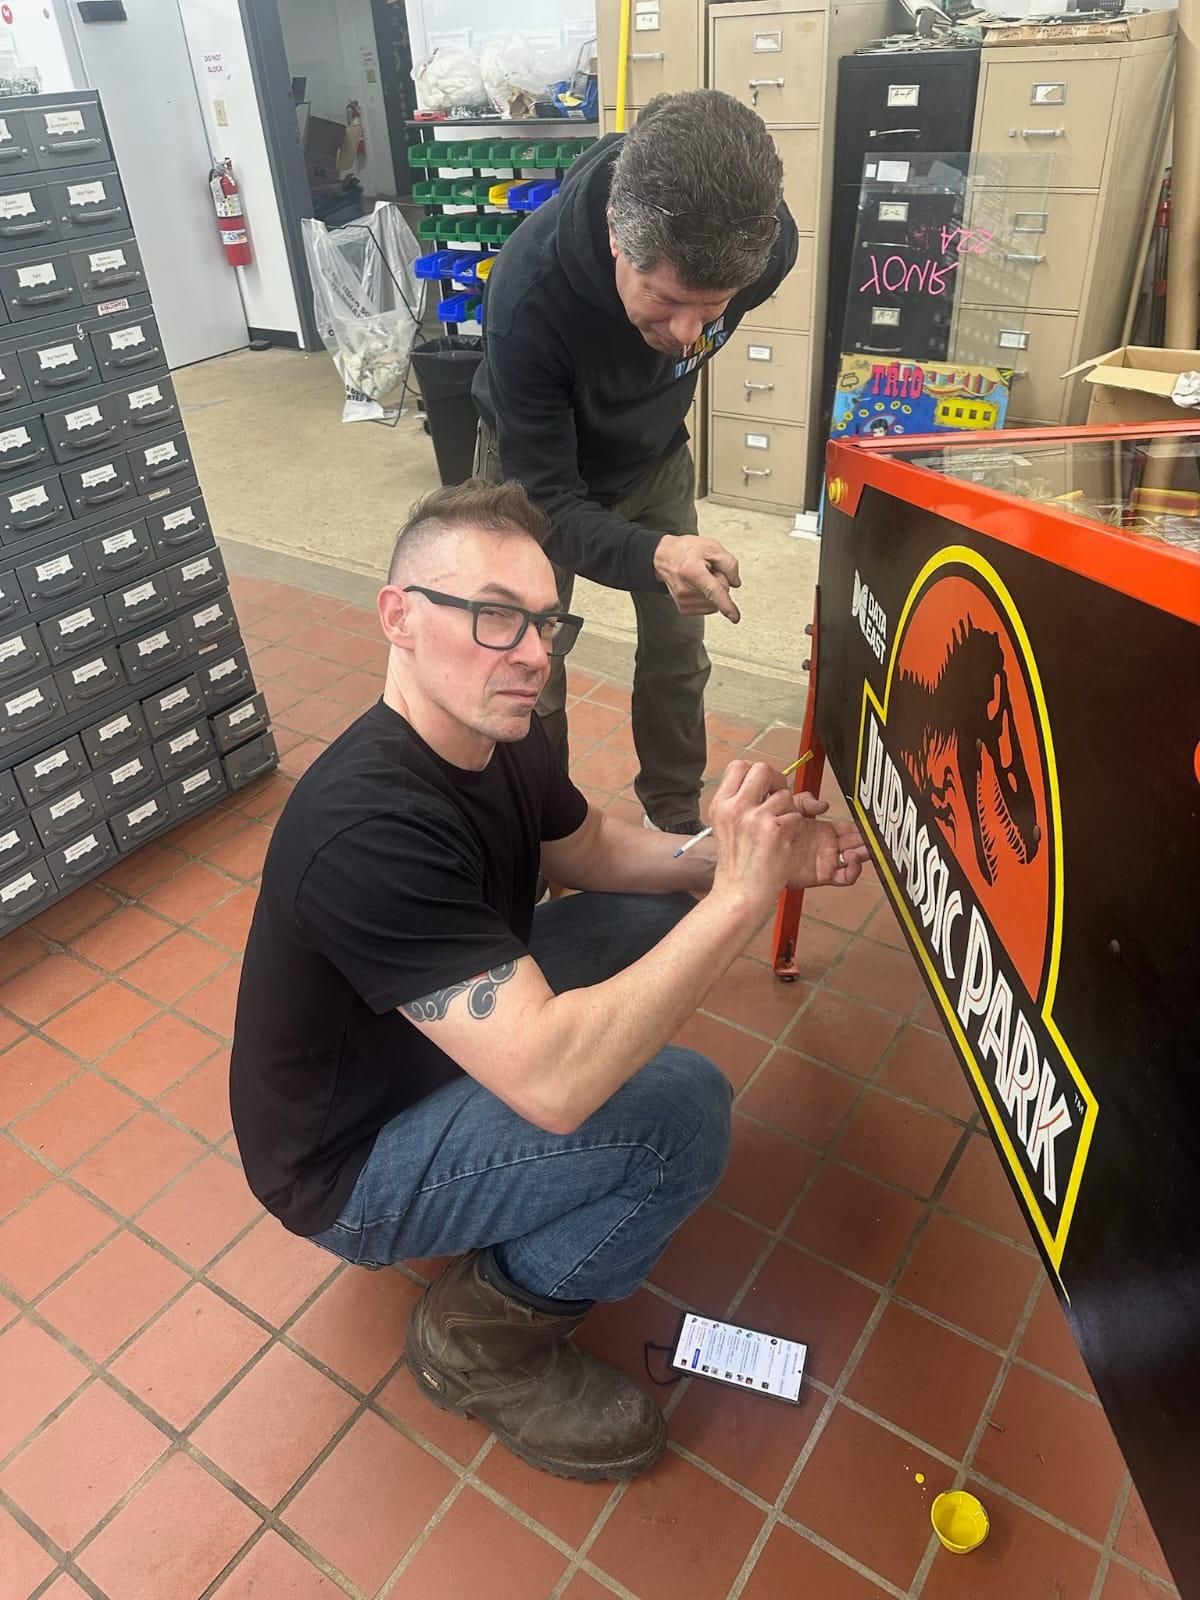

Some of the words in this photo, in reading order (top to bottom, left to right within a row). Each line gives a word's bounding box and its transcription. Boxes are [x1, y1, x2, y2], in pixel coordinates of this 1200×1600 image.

[207, 65, 223, 73] BLOCK
[100, 300, 127, 311] EQUIPTO
[871, 362, 924, 399] TRIO
[868, 591, 887, 640] DATA
[865, 616, 886, 665] EAST
[859, 712, 964, 979] JURASSIC
[957, 904, 1073, 1206] PARK
